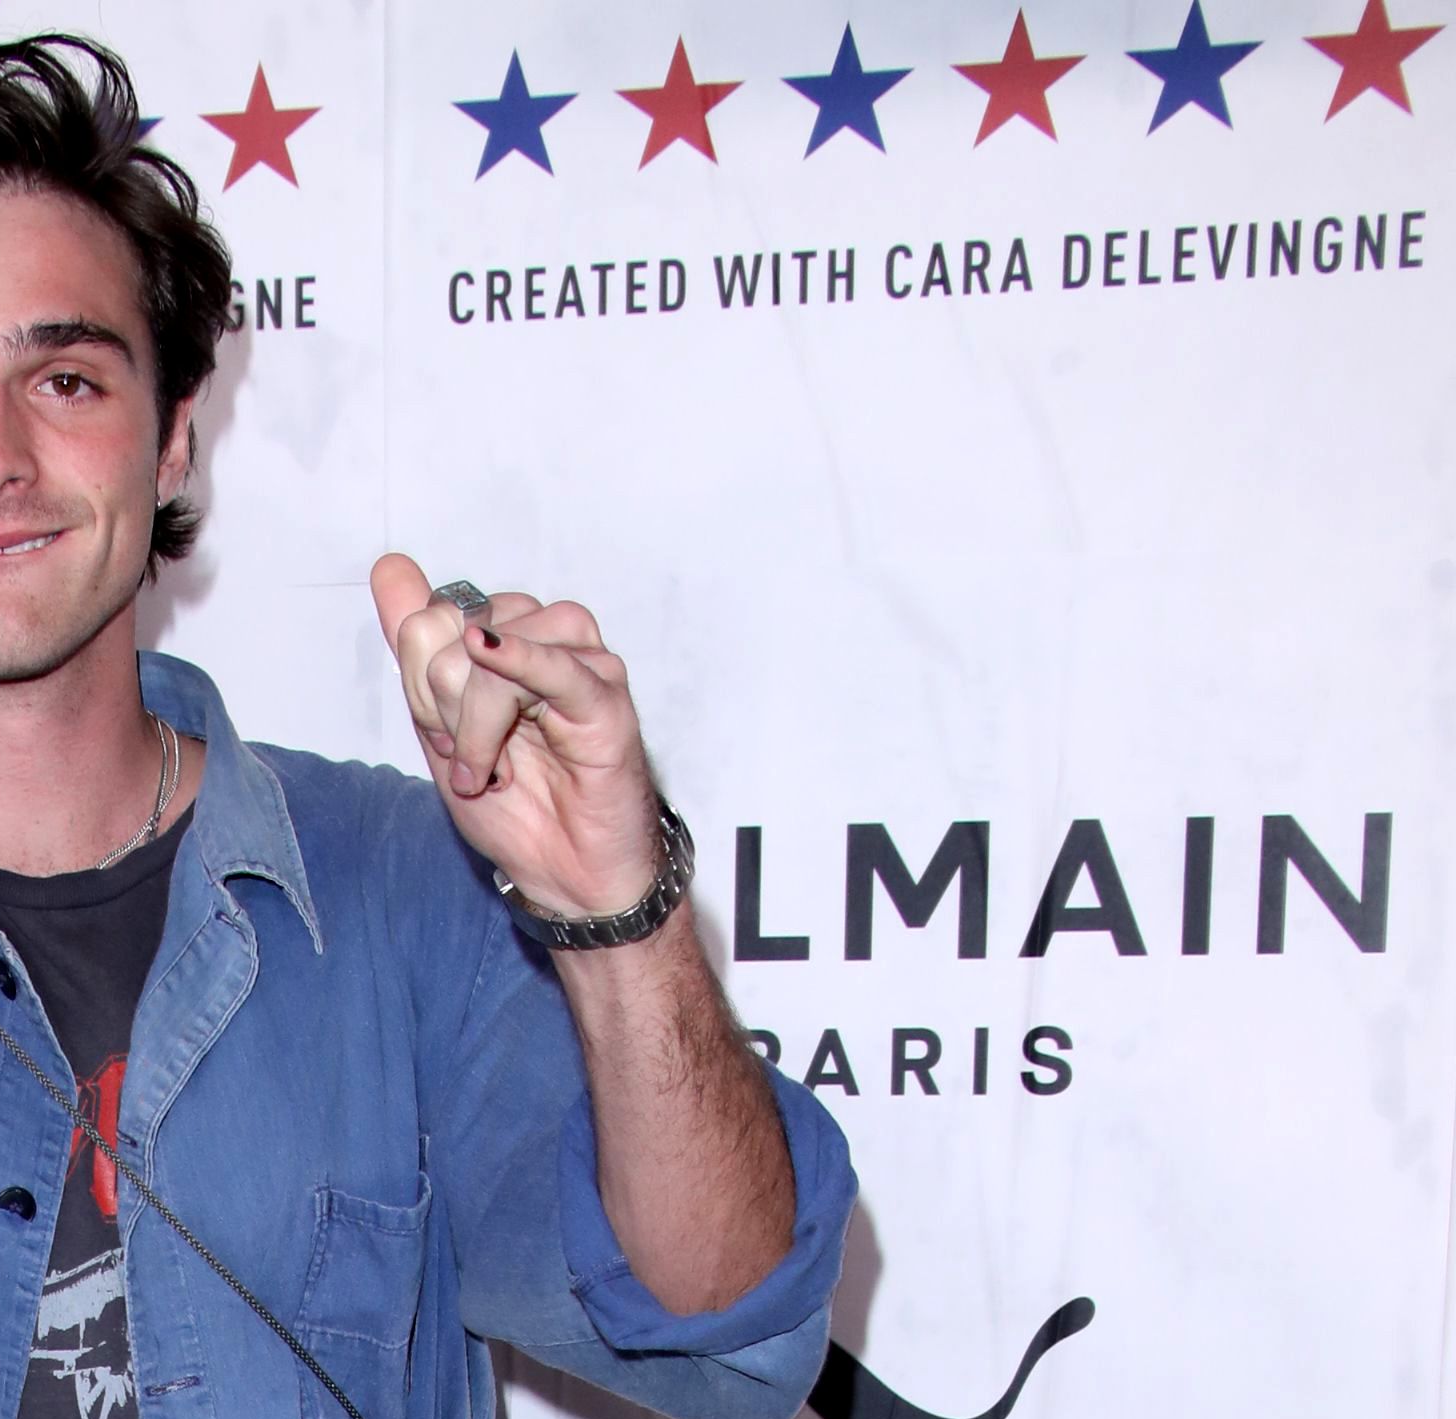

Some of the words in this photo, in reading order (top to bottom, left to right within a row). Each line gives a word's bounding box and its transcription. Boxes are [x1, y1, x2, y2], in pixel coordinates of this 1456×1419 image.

[448, 259, 686, 325] CREATED
[713, 248, 855, 309] WITH
[885, 237, 1033, 300] CARA
[1062, 211, 1426, 289] DELEVINGNE
[733, 812, 1392, 962] LMAIN
